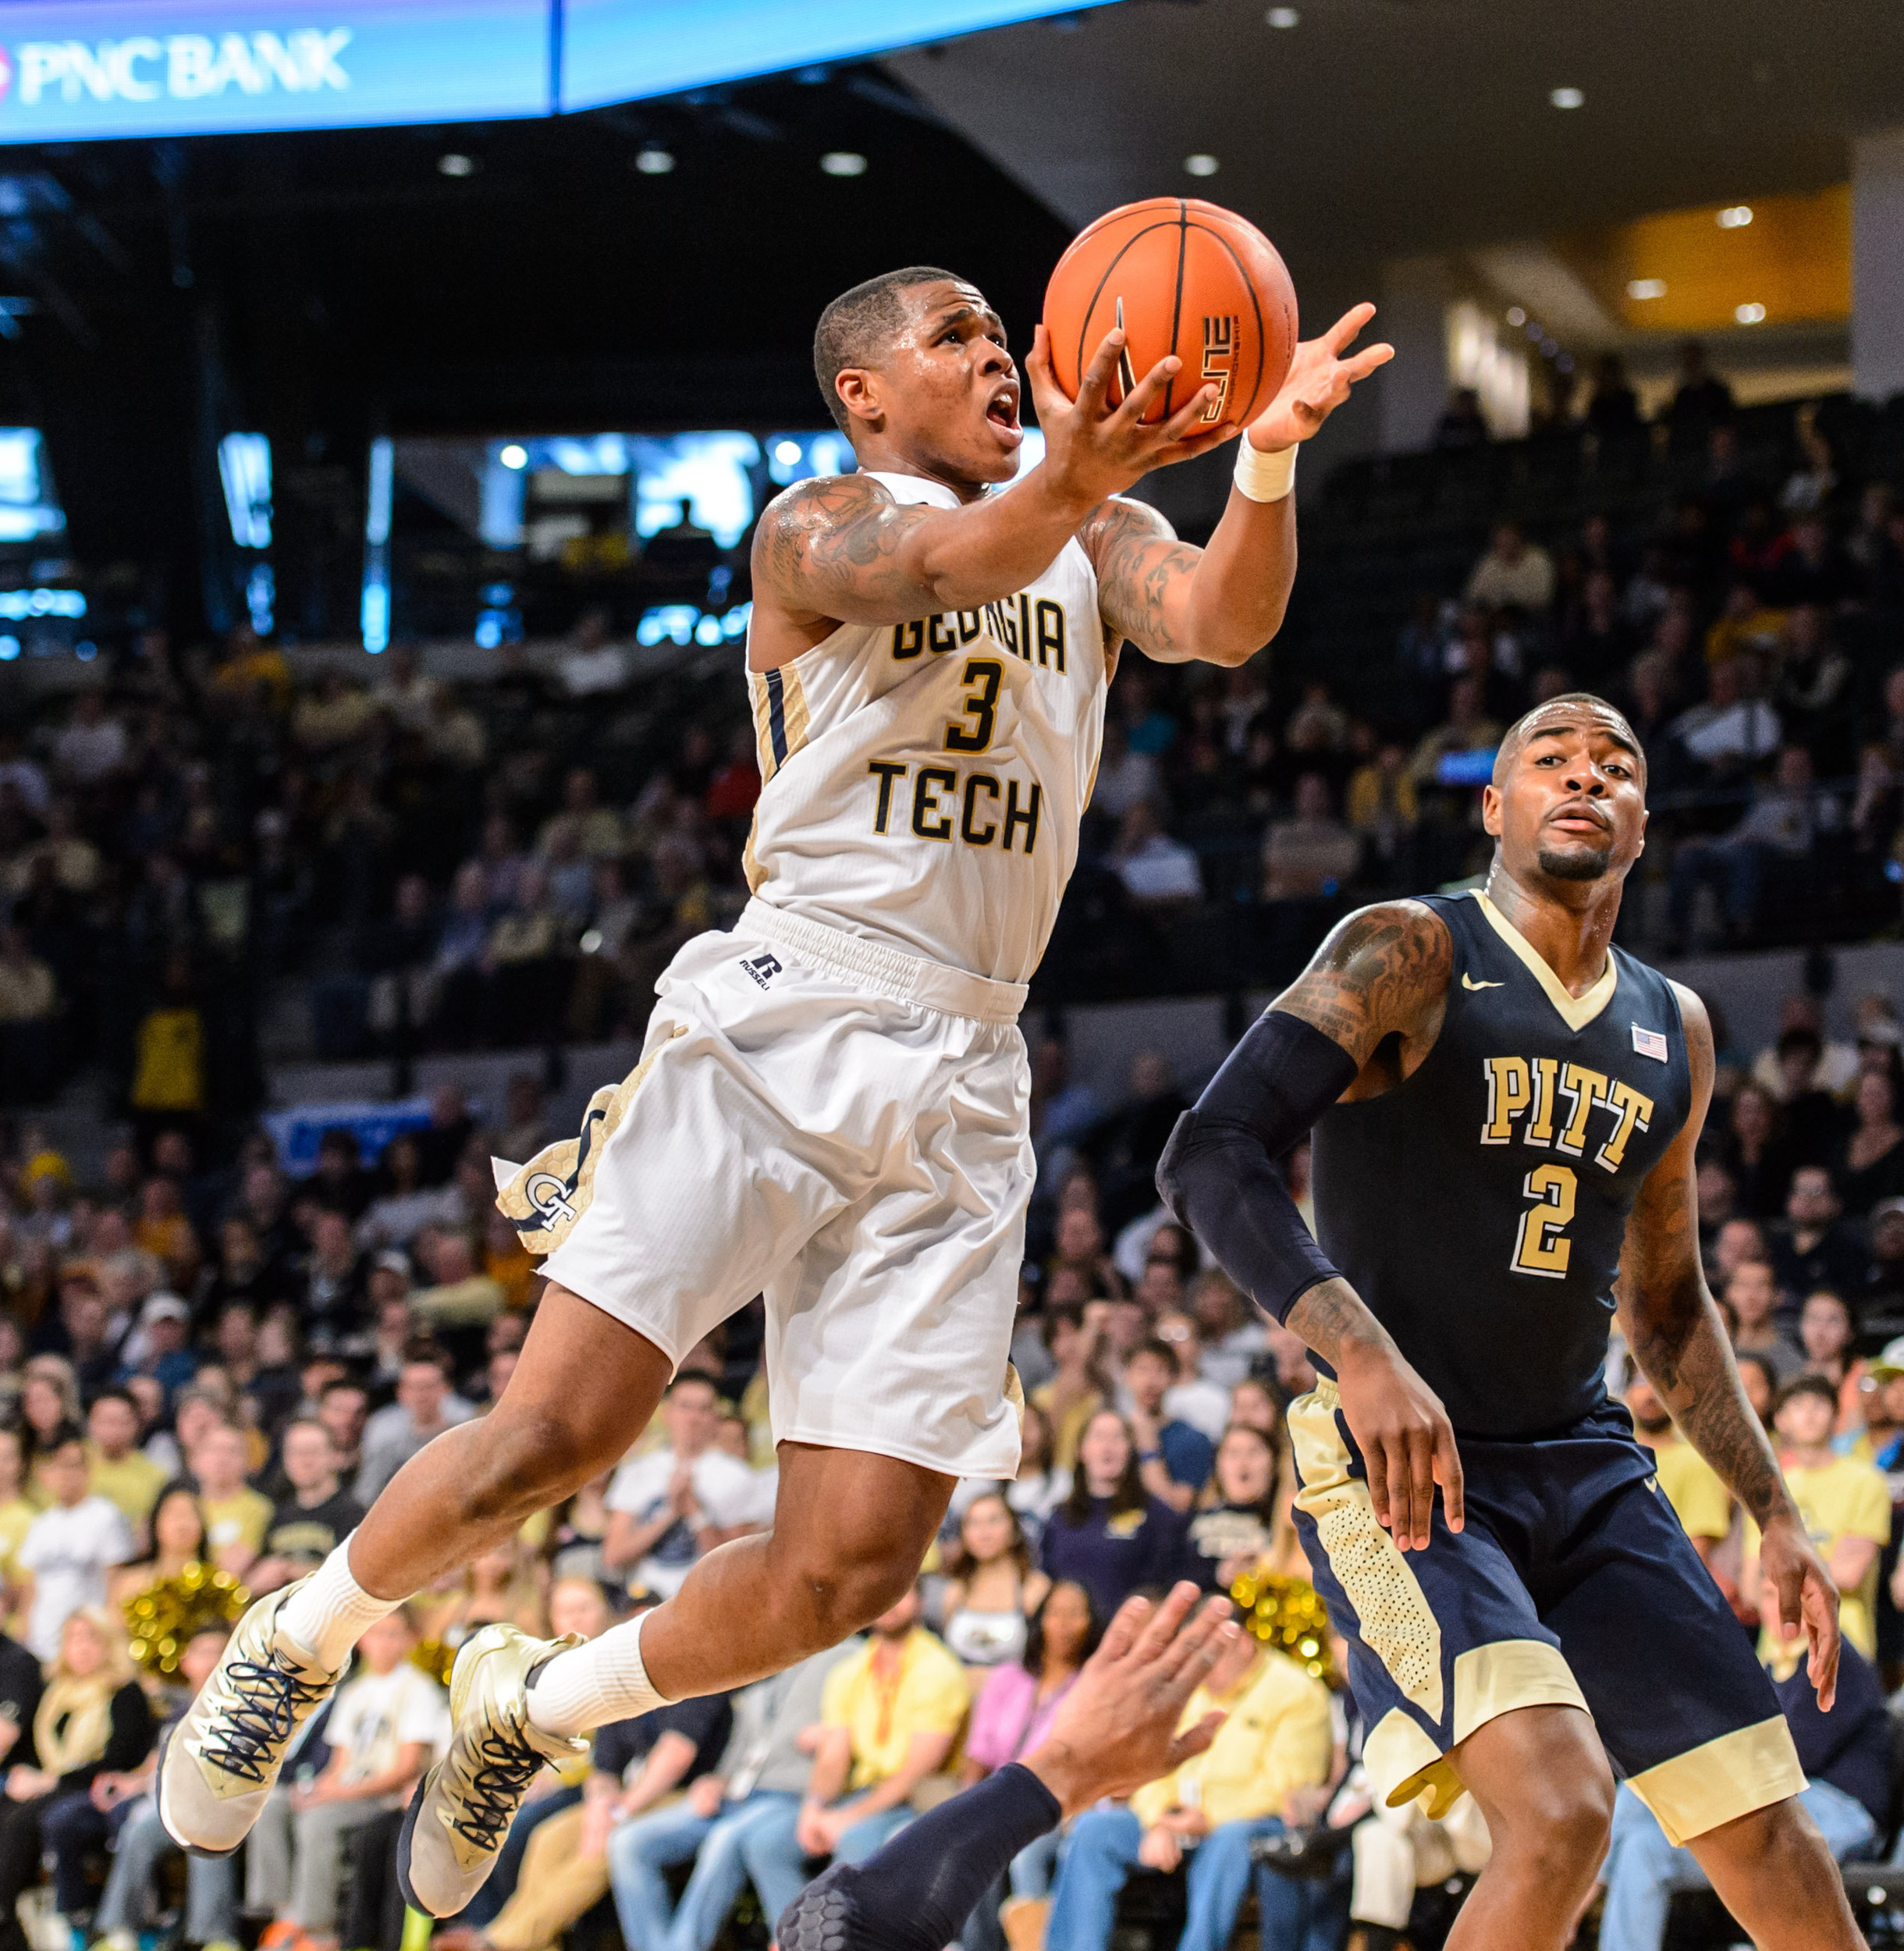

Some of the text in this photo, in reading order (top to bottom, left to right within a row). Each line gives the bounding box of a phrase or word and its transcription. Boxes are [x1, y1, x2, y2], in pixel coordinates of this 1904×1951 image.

[19, 27, 352, 105] PNC BANK
[891, 592, 1067, 676] GEORGIA
[943, 657, 1006, 755] 3
[868, 759, 1043, 855] TECH
[1480, 1056, 1655, 1174] PITT
[1509, 1164, 1578, 1280] 2
